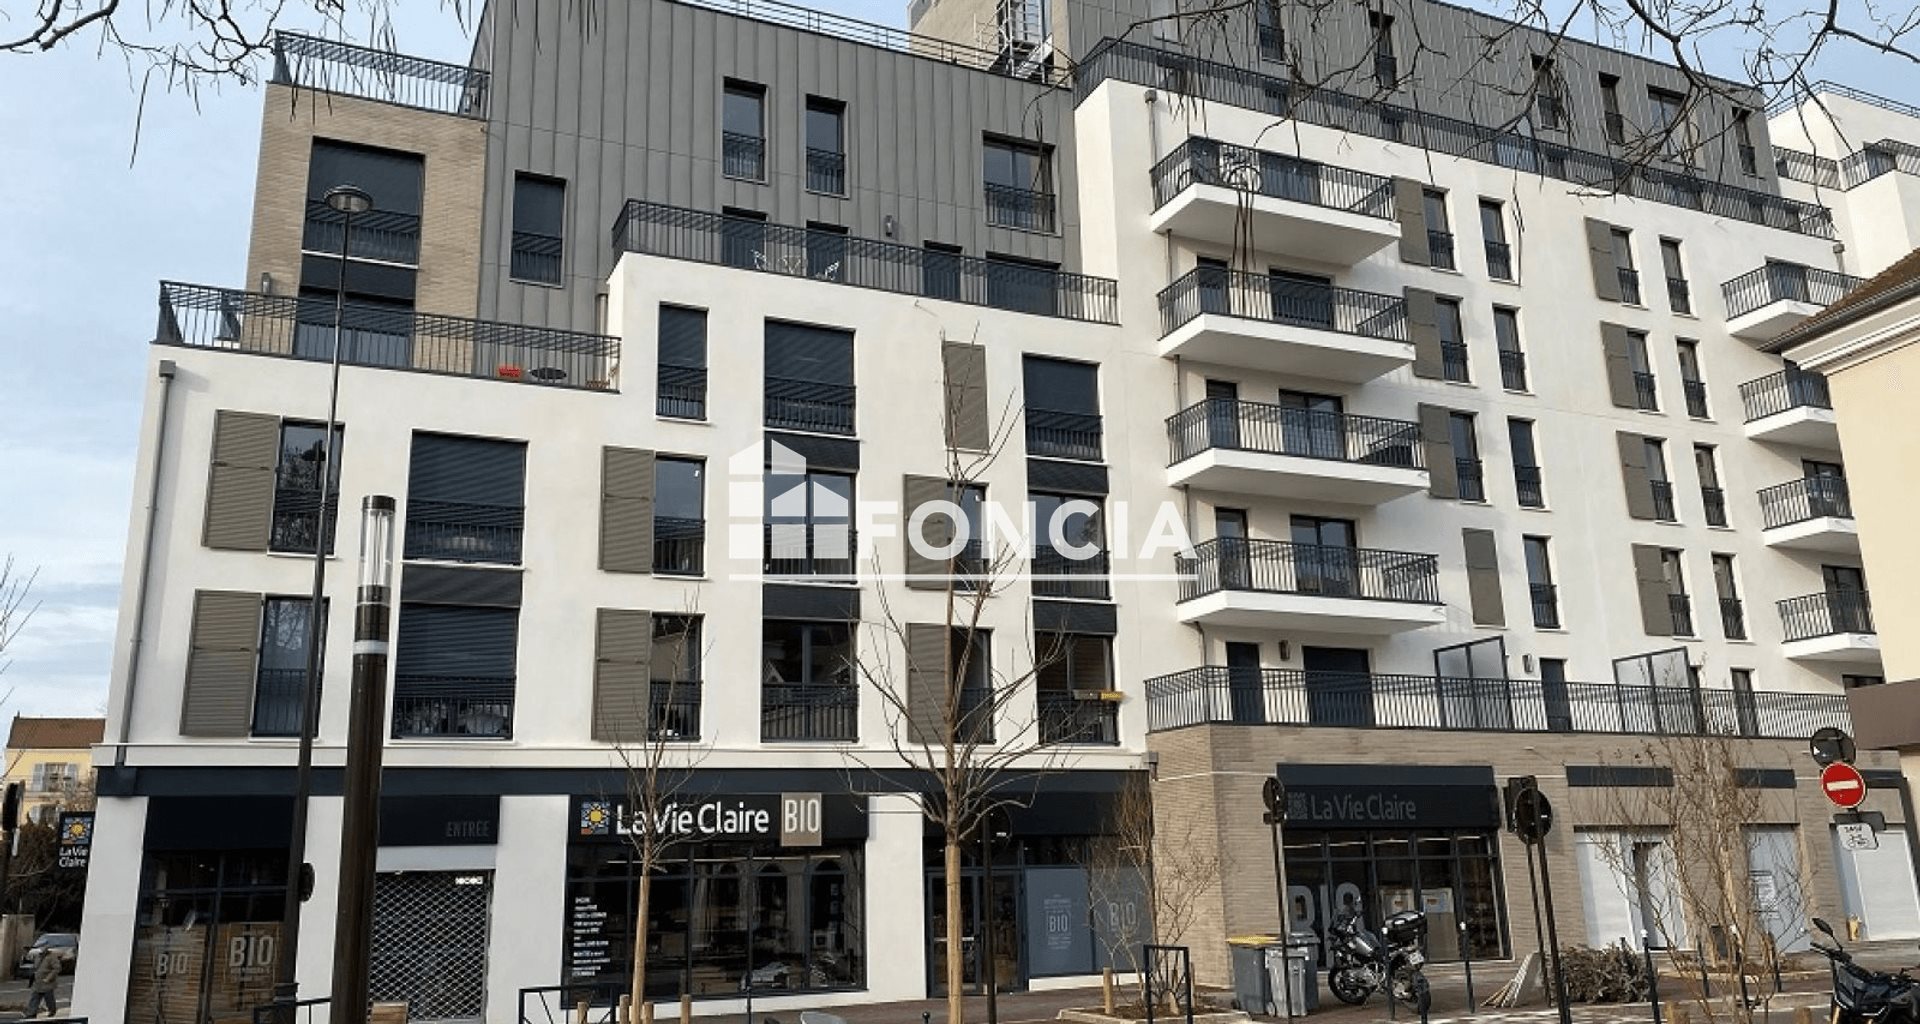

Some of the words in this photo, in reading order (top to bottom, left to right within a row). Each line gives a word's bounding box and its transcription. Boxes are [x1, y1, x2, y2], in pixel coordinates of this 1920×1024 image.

[616, 804, 646, 834] La
[653, 802, 692, 833] Vie
[698, 802, 769, 833] Claire
[784, 799, 820, 834] BIO
[1311, 795, 1332, 819] La
[1333, 794, 1364, 819] Vie
[1367, 792, 1416, 819] Claire
[59, 856, 86, 867] Claire
[1049, 914, 1069, 932] BIO
[156, 952, 188, 976] BIO
[229, 936, 274, 967] BIO
